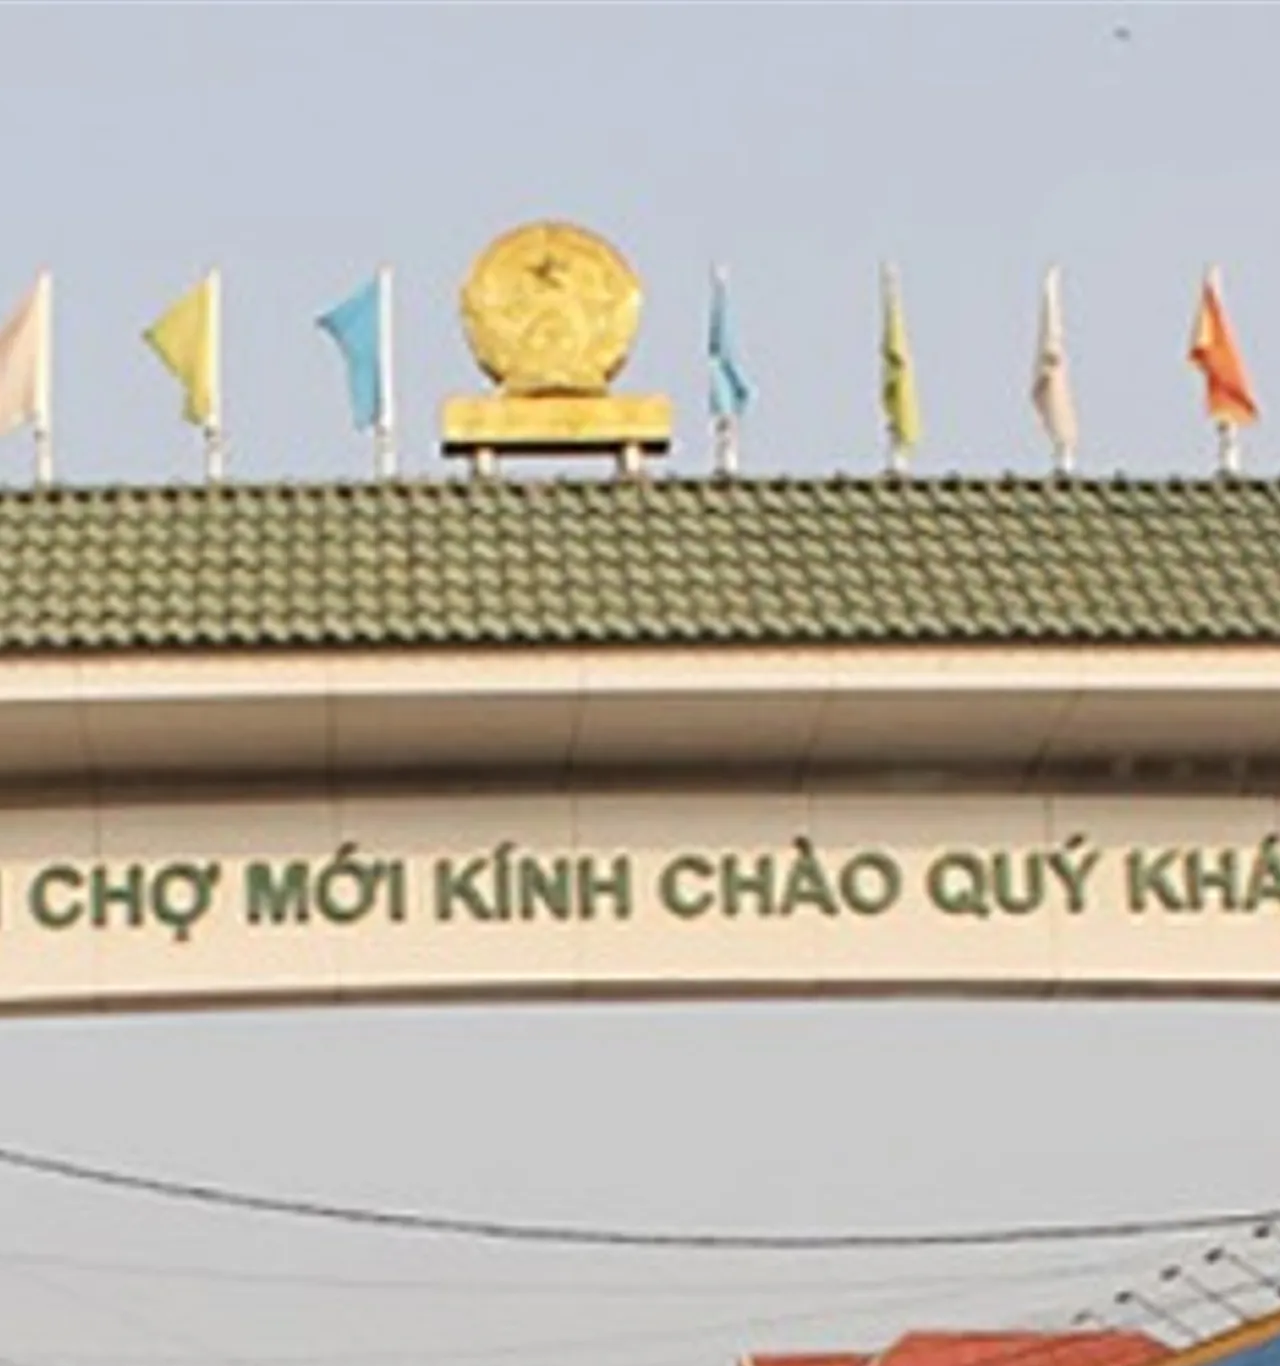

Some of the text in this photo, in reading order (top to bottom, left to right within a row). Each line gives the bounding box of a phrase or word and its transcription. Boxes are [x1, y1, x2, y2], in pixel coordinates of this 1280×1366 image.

[29, 862, 219, 941] CHỢ
[246, 842, 405, 924] MỚI
[434, 841, 630, 920] KÍNH
[659, 836, 900, 918] CHÀO
[927, 835, 1098, 918] QUÝ
